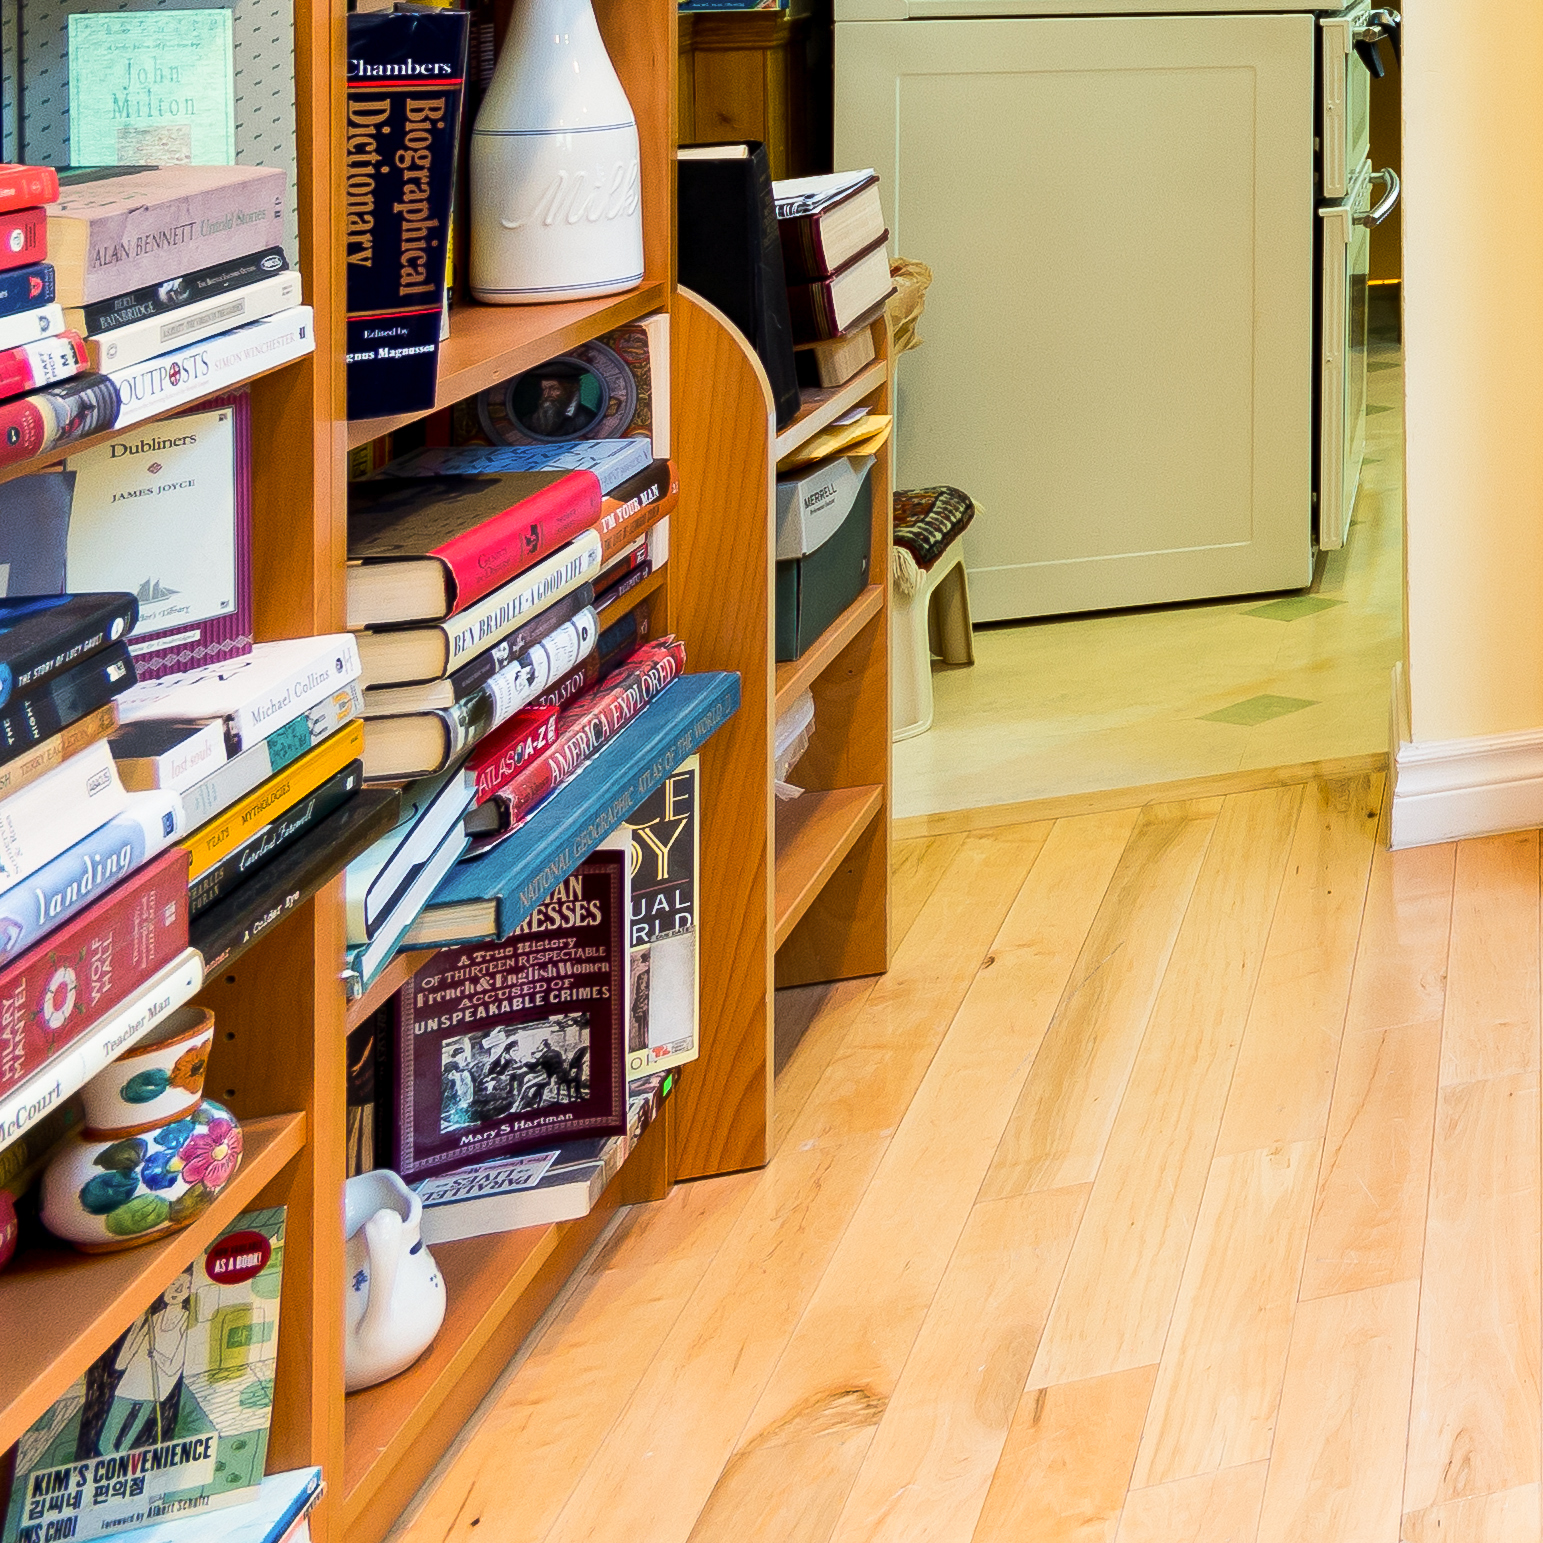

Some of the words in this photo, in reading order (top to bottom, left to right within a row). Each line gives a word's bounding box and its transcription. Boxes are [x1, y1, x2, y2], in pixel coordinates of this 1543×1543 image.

[346, 98, 391, 269] Dictionary
[394, 97, 446, 297] Biographical
[93, 238, 132, 268] ALAN
[135, 221, 198, 263] BENNETT
[110, 432, 197, 459] Dubliners
[111, 488, 154, 504] JAMES
[157, 479, 196, 495] JOYCE
[454, 626, 475, 657] BEN
[479, 594, 523, 641] BRADLEE
[530, 588, 535, 606] A
[537, 569, 562, 601] GOOD
[565, 555, 583, 583] LIFE
[550, 716, 611, 784] AMERICA
[612, 654, 676, 732] EXPLORED
[37, 843, 132, 925] landing
[91, 937, 101, 1007] WOLF
[102, 929, 113, 992] HALL
[103, 1014, 146, 1059] Teacher
[148, 995, 171, 1025] Man
[414, 994, 545, 1036] UNSPEAKABLE
[549, 986, 610, 1003] CRIMES
[459, 1127, 497, 1146] Mary
[501, 1123, 511, 1134] S
[514, 1112, 574, 1132] Hartman
[32, 1462, 89, 1498] KIM'S
[93, 1436, 213, 1486] CONVENIENCE
[92, 1475, 146, 1506] 편의점
[45, 1515, 78, 1541] CHOI
